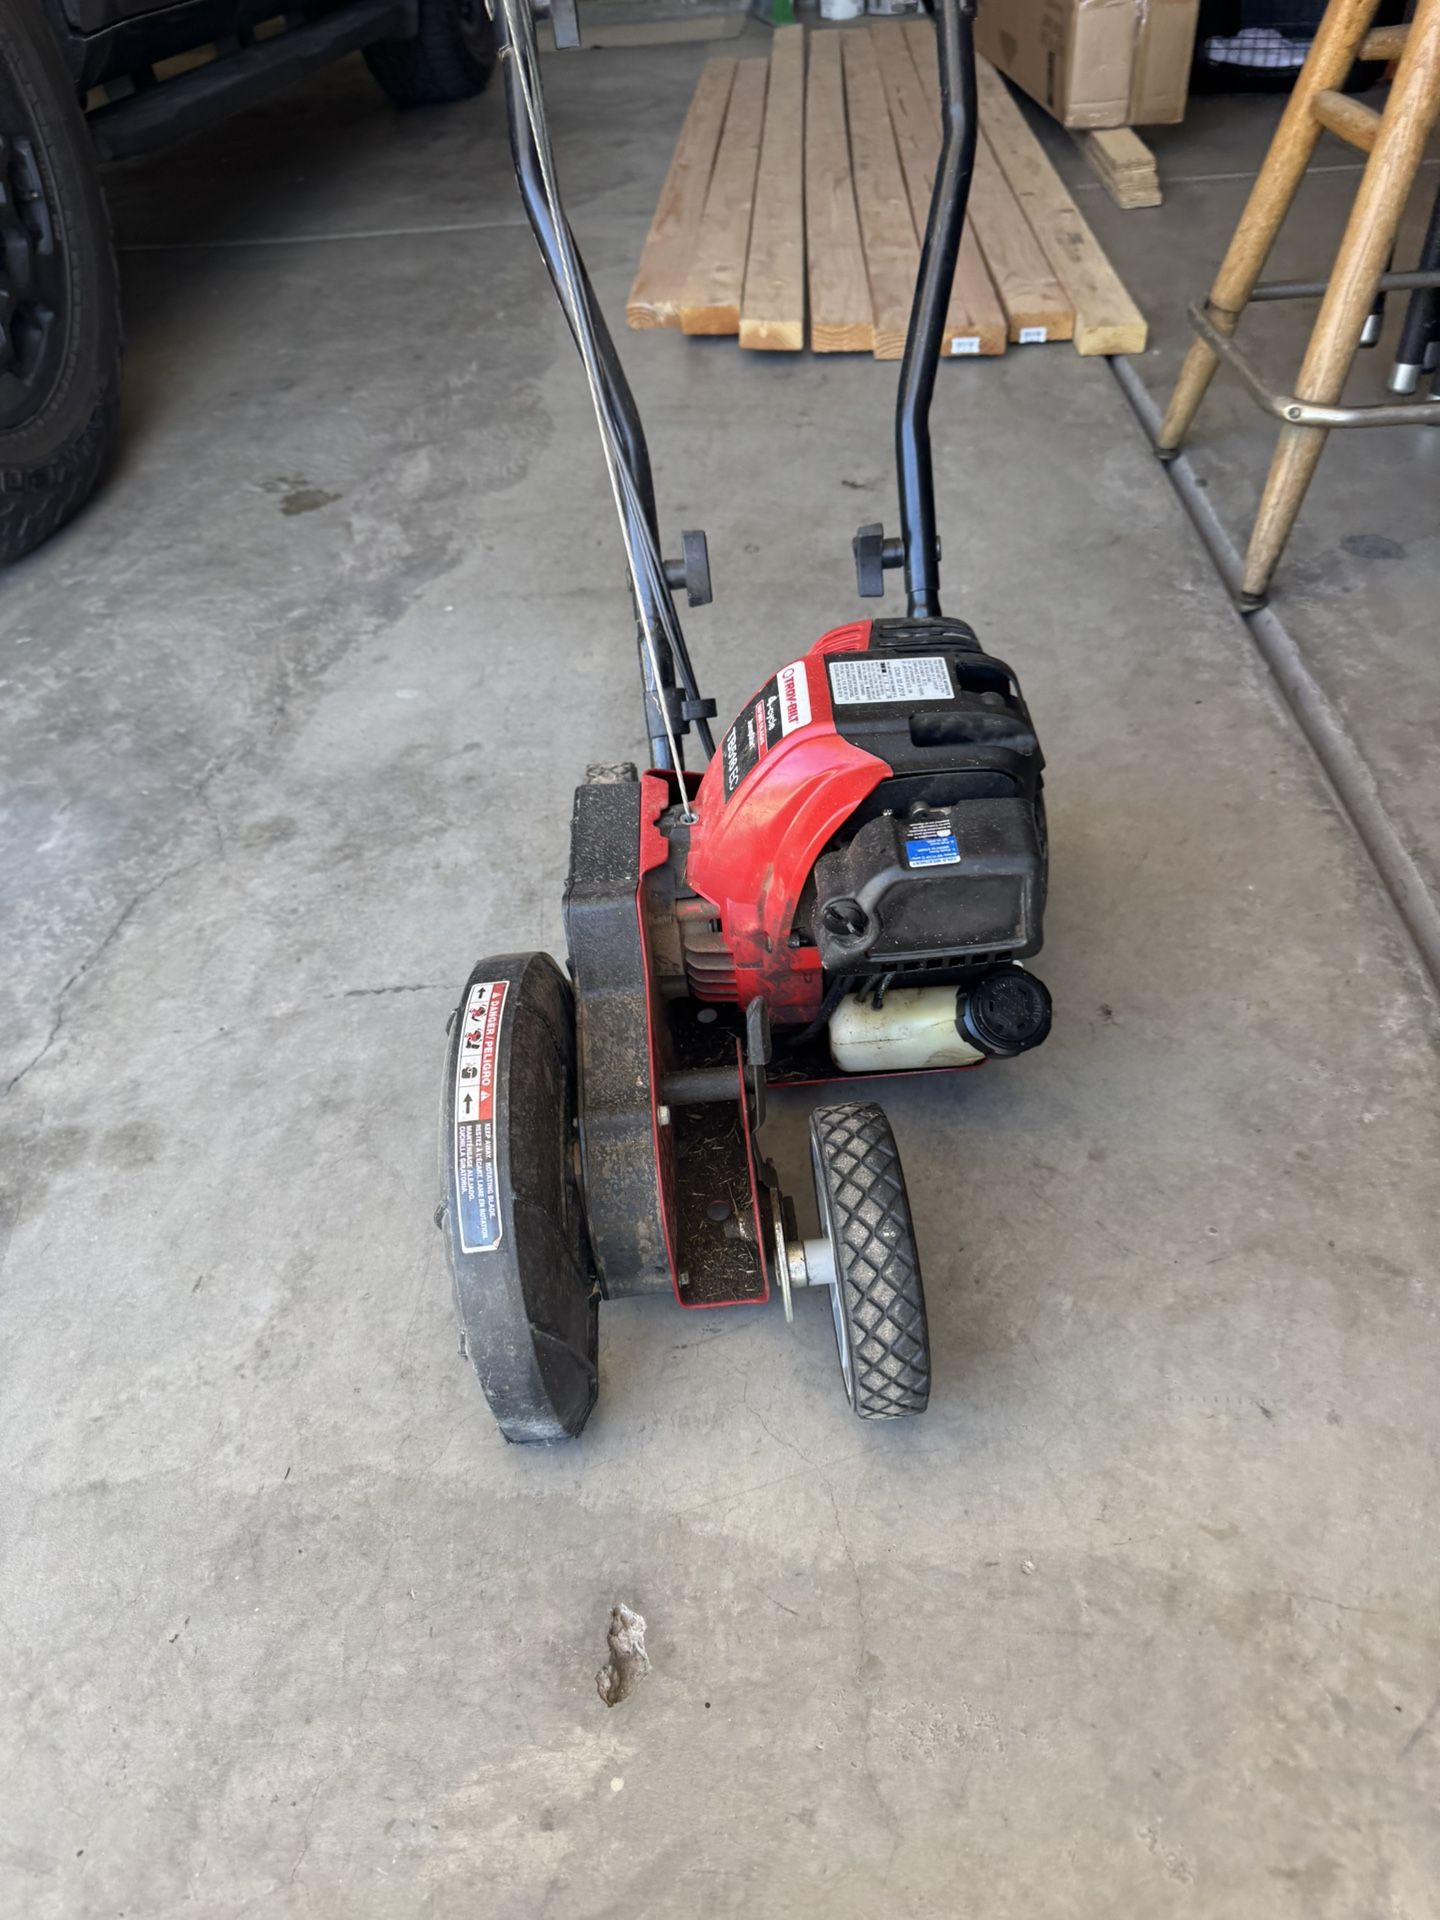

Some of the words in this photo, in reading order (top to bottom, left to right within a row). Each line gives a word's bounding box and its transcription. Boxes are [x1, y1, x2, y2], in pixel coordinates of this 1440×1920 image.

[766, 695, 777, 731] 4-cycle
[784, 676, 799, 723] TROY-BILT
[484, 1122, 492, 1139] KEEP
[477, 1180, 485, 1198] LAME
[486, 1162, 494, 1194] ROTATING
